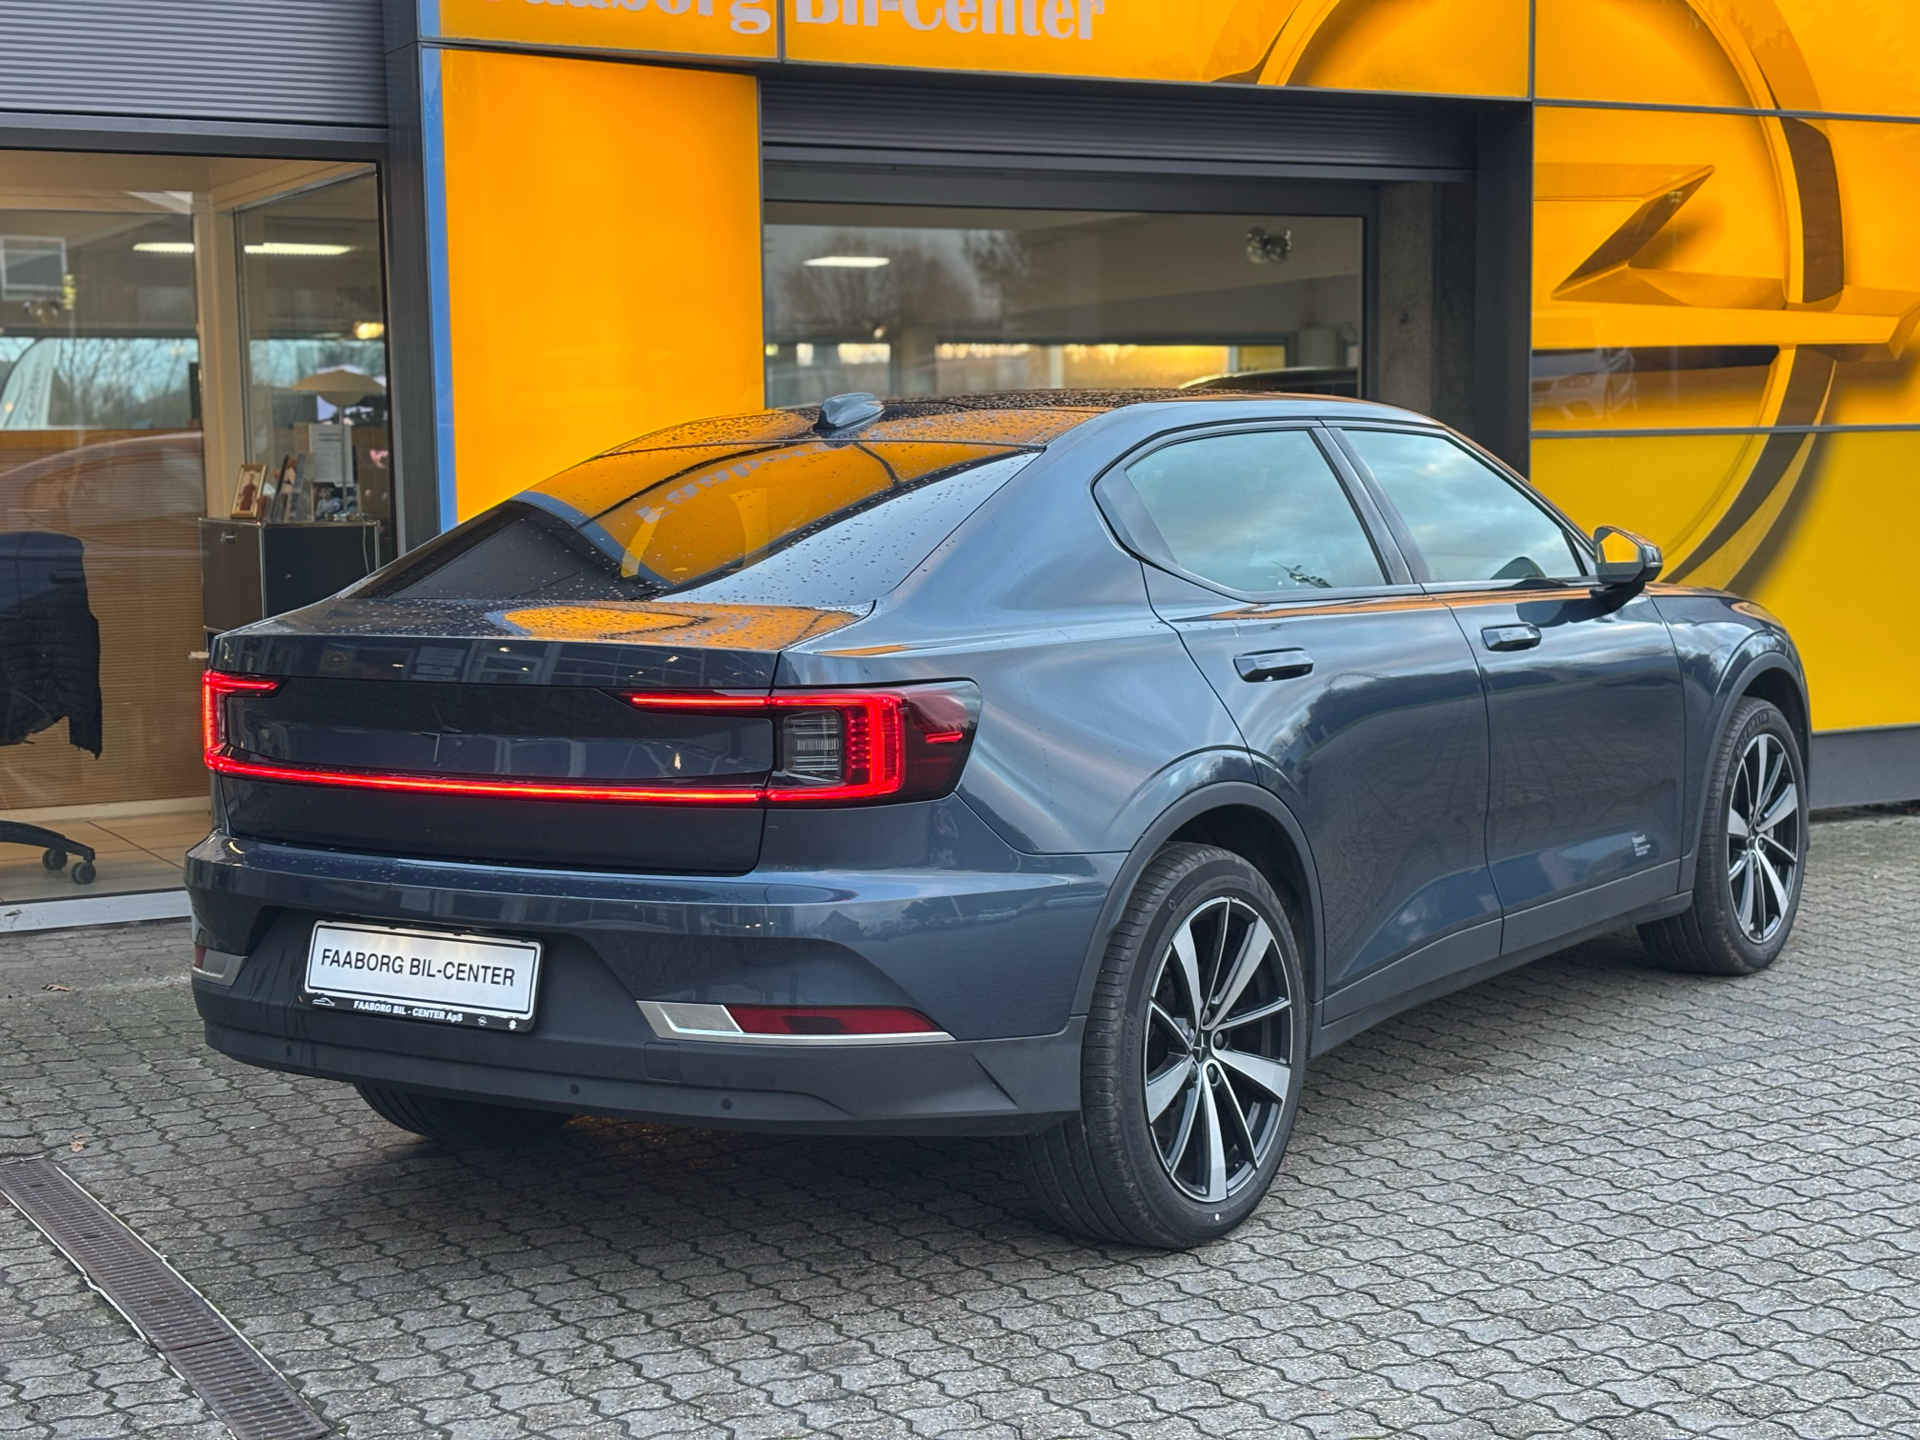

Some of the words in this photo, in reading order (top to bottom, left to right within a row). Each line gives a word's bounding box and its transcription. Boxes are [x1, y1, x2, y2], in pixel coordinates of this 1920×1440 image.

[320, 948, 405, 974] FAABORG
[409, 958, 516, 987] BIL-CENTER
[353, 1000, 392, 1013] FAABORG
[392, 1005, 407, 1015] BIL
[412, 1008, 446, 1020] CENTER
[446, 1012, 464, 1023] ApS
